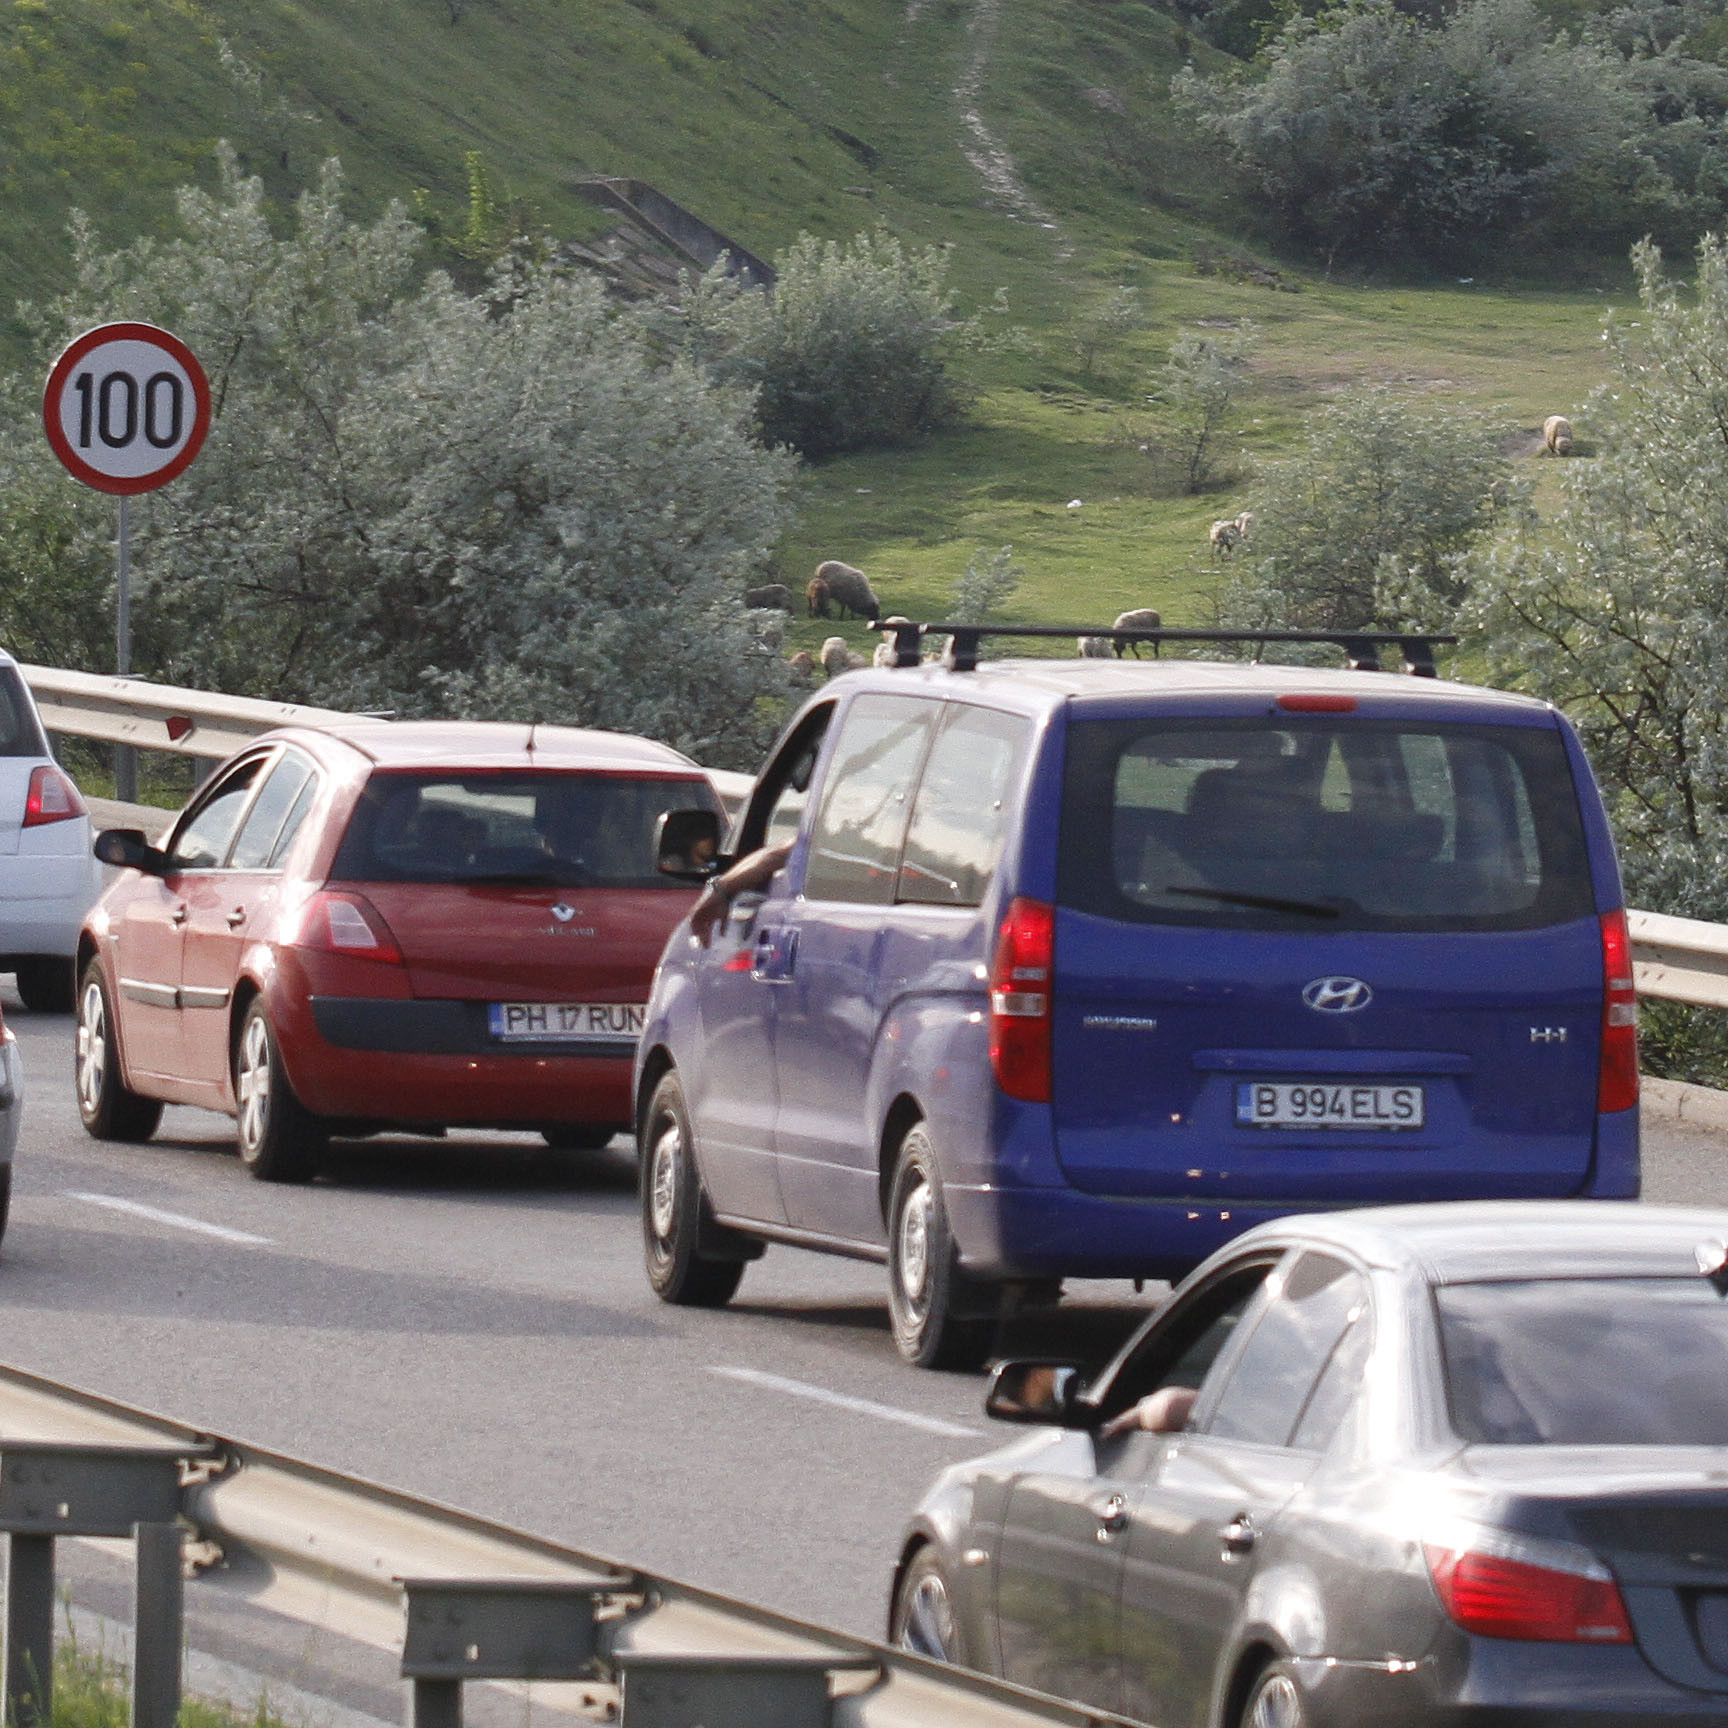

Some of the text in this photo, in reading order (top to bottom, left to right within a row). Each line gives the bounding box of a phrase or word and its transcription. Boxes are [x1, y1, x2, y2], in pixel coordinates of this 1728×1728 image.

[75, 371, 184, 450] 100
[506, 1006, 646, 1033] PH 17 RUN
[1256, 1086, 1278, 1118] B
